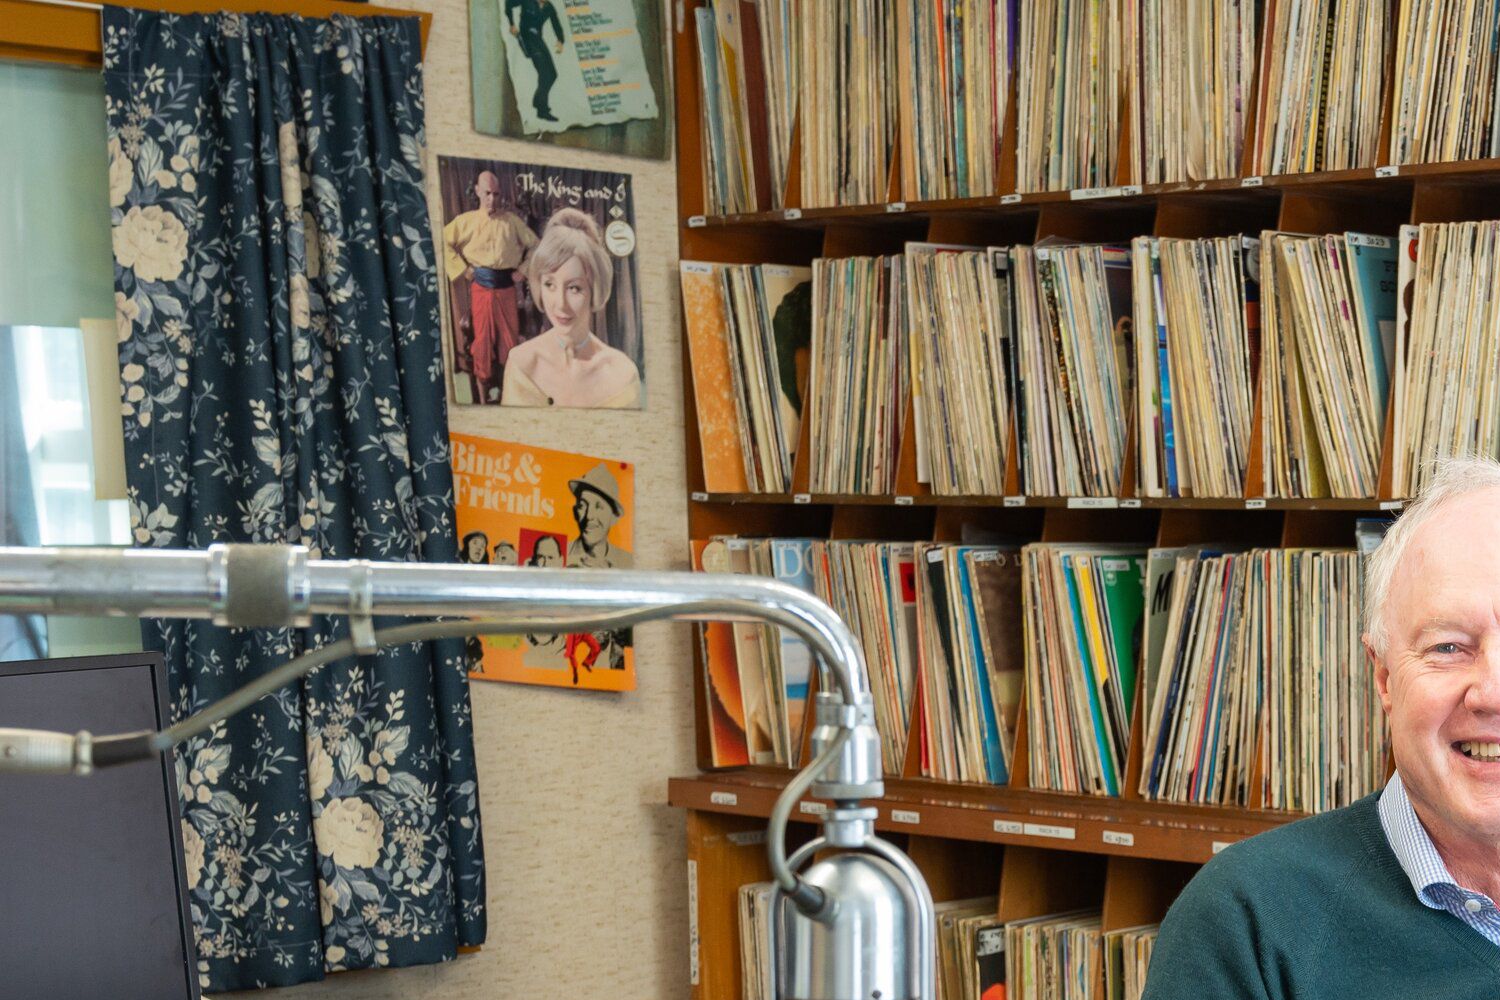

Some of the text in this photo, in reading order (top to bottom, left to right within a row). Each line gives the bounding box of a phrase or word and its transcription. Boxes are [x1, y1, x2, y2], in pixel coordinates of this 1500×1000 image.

[515, 172, 546, 198] The
[547, 176, 582, 205] King
[584, 187, 613, 200] and
[451, 440, 544, 487] Bing &
[453, 473, 556, 520] Friends
